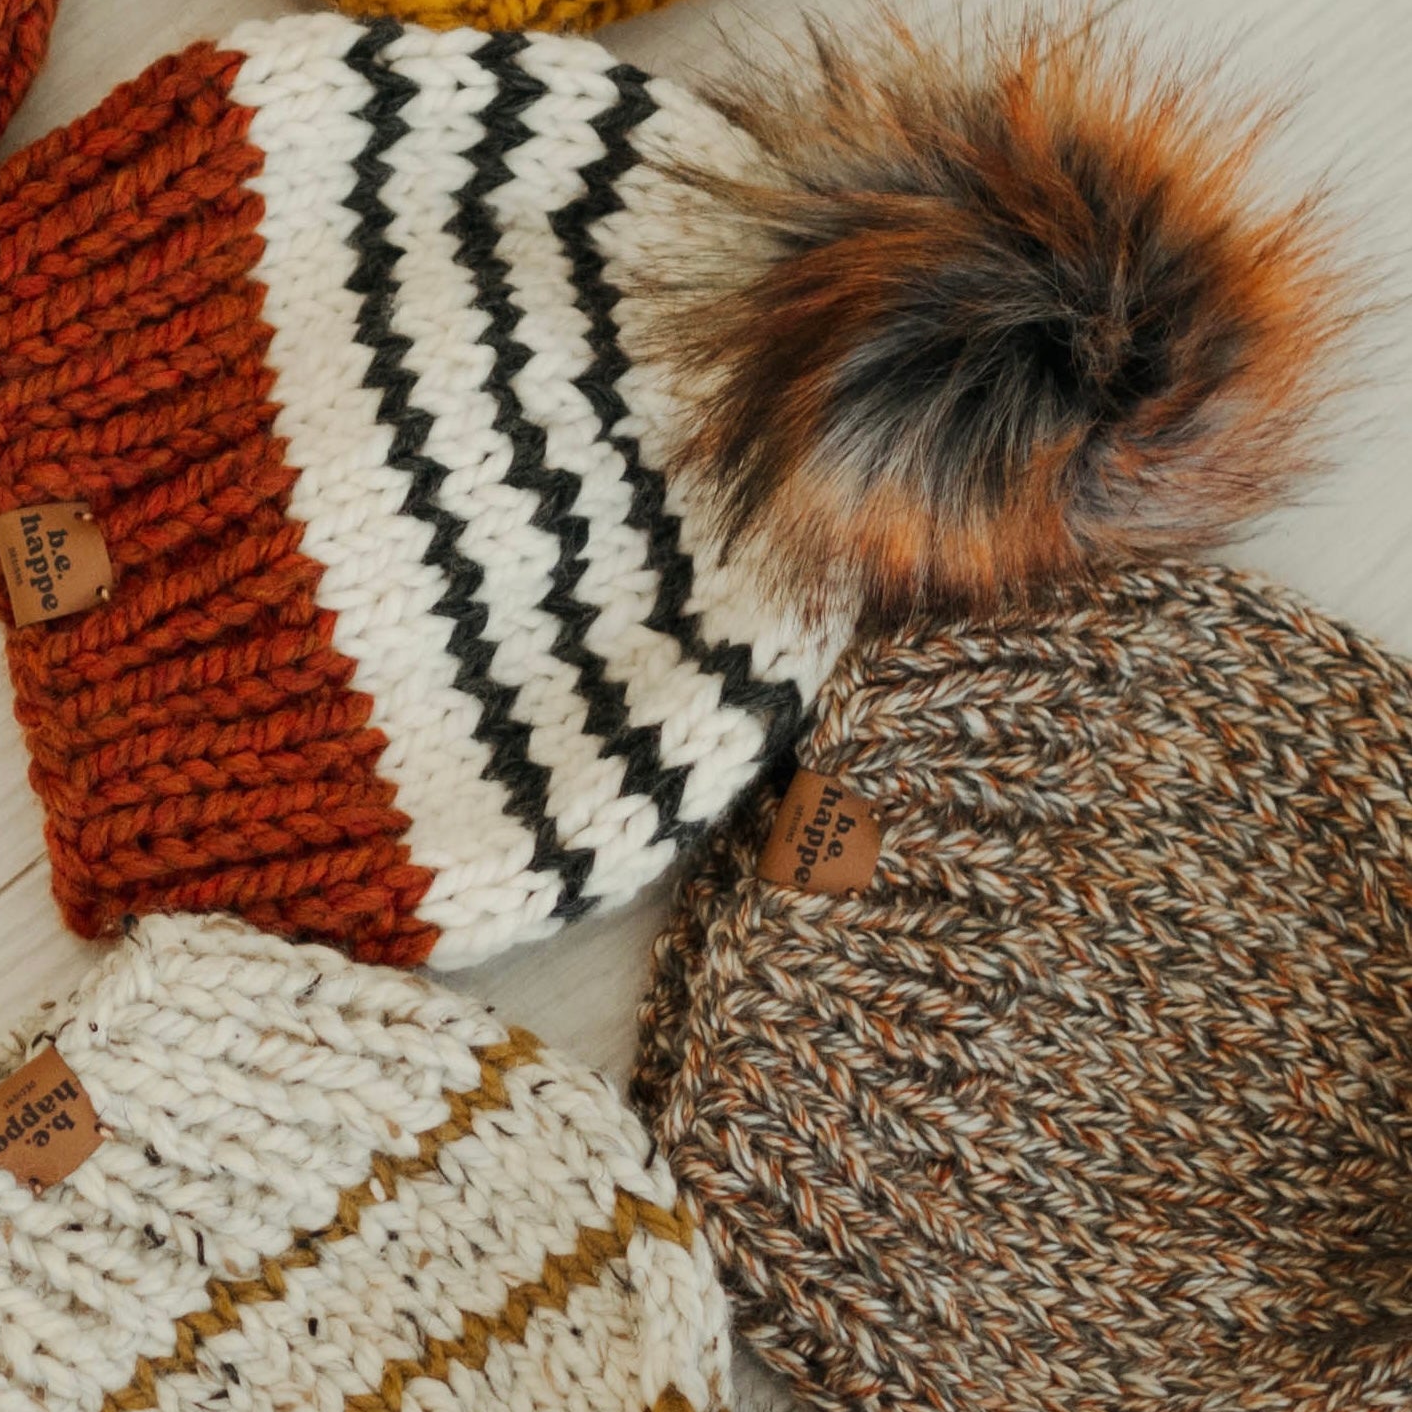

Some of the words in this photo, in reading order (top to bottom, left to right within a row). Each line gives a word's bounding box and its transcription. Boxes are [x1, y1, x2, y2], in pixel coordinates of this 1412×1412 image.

[20, 513, 58, 611] happe
[48, 529, 72, 580] b.e.
[794, 786, 844, 885] happe
[822, 814, 856, 862] b.e.
[25, 1110, 76, 1148] b.e.
